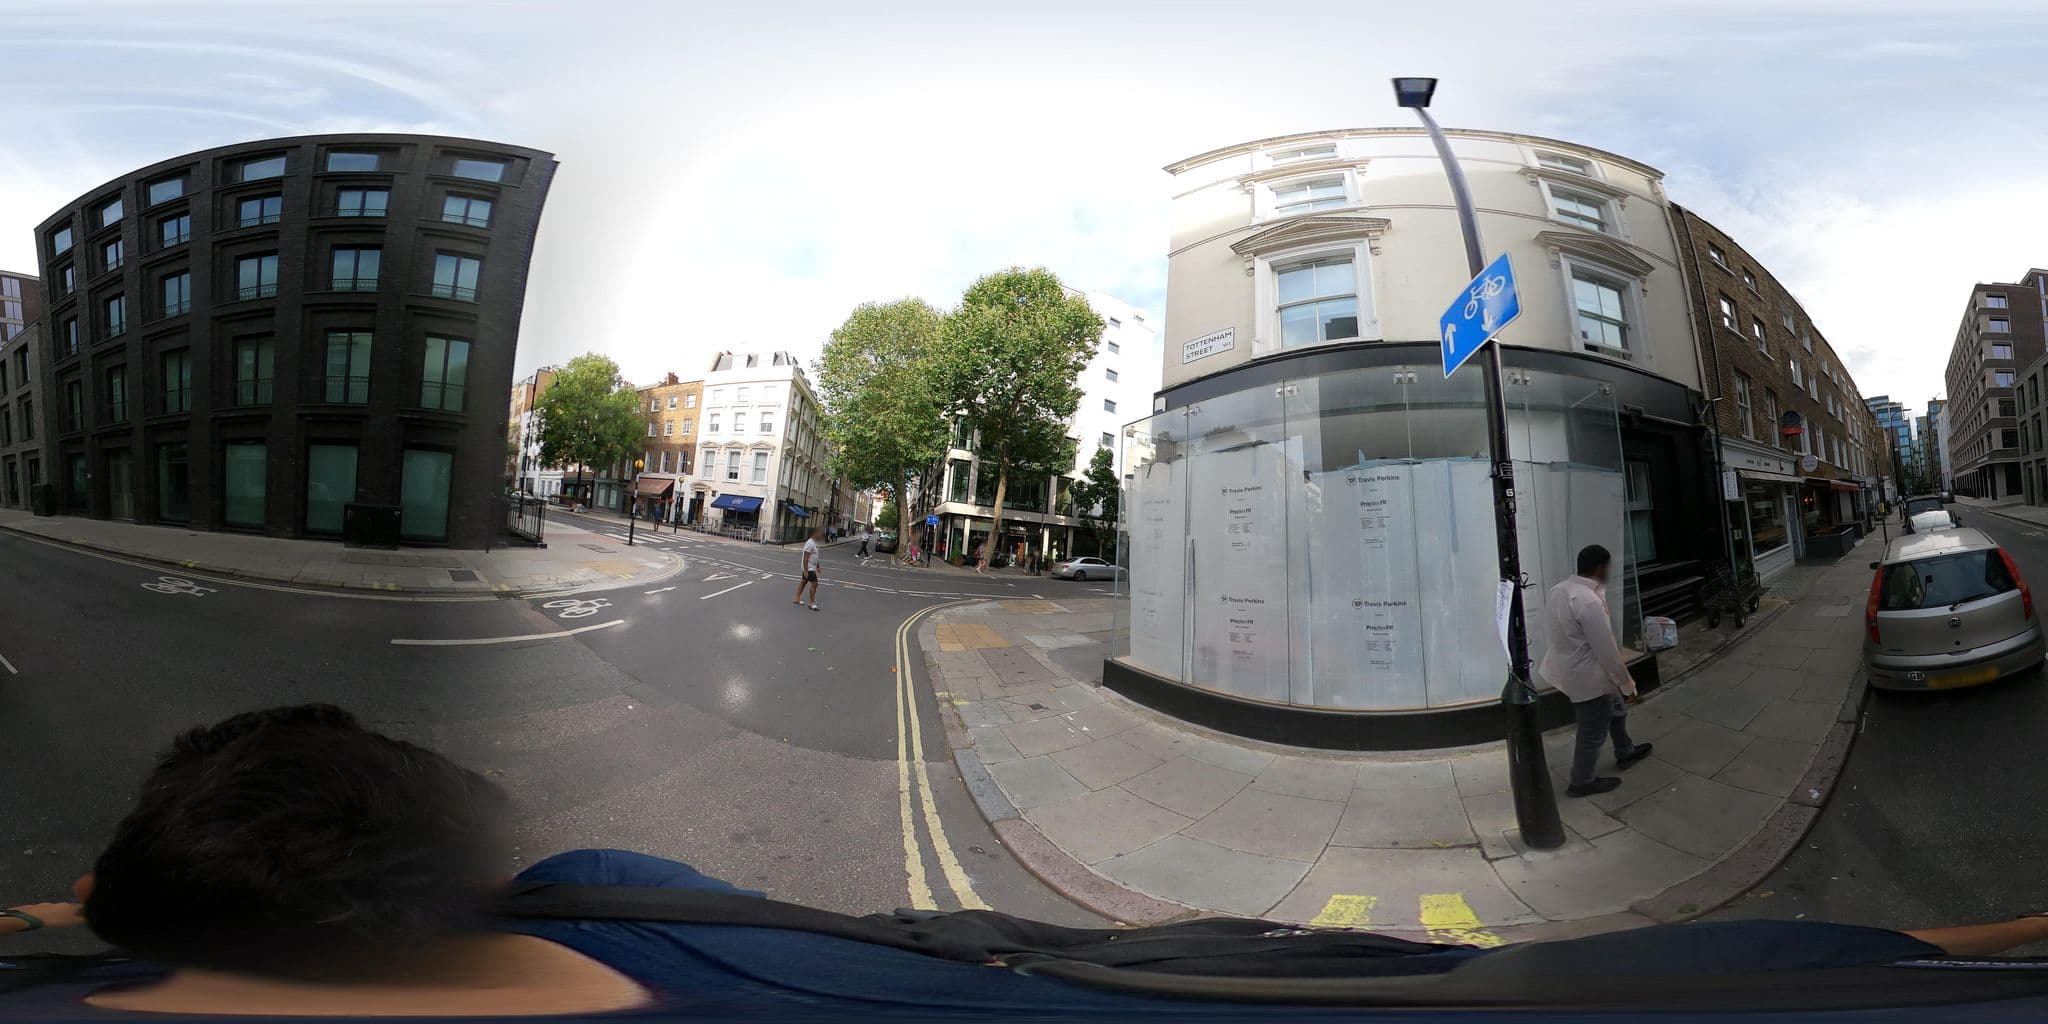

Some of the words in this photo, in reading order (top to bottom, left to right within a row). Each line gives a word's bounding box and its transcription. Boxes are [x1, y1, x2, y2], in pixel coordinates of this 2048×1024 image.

[1186, 332, 1232, 350] TOTTENHAM
[1186, 345, 1213, 359] STREET
[1909, 672, 1924, 680] GB
